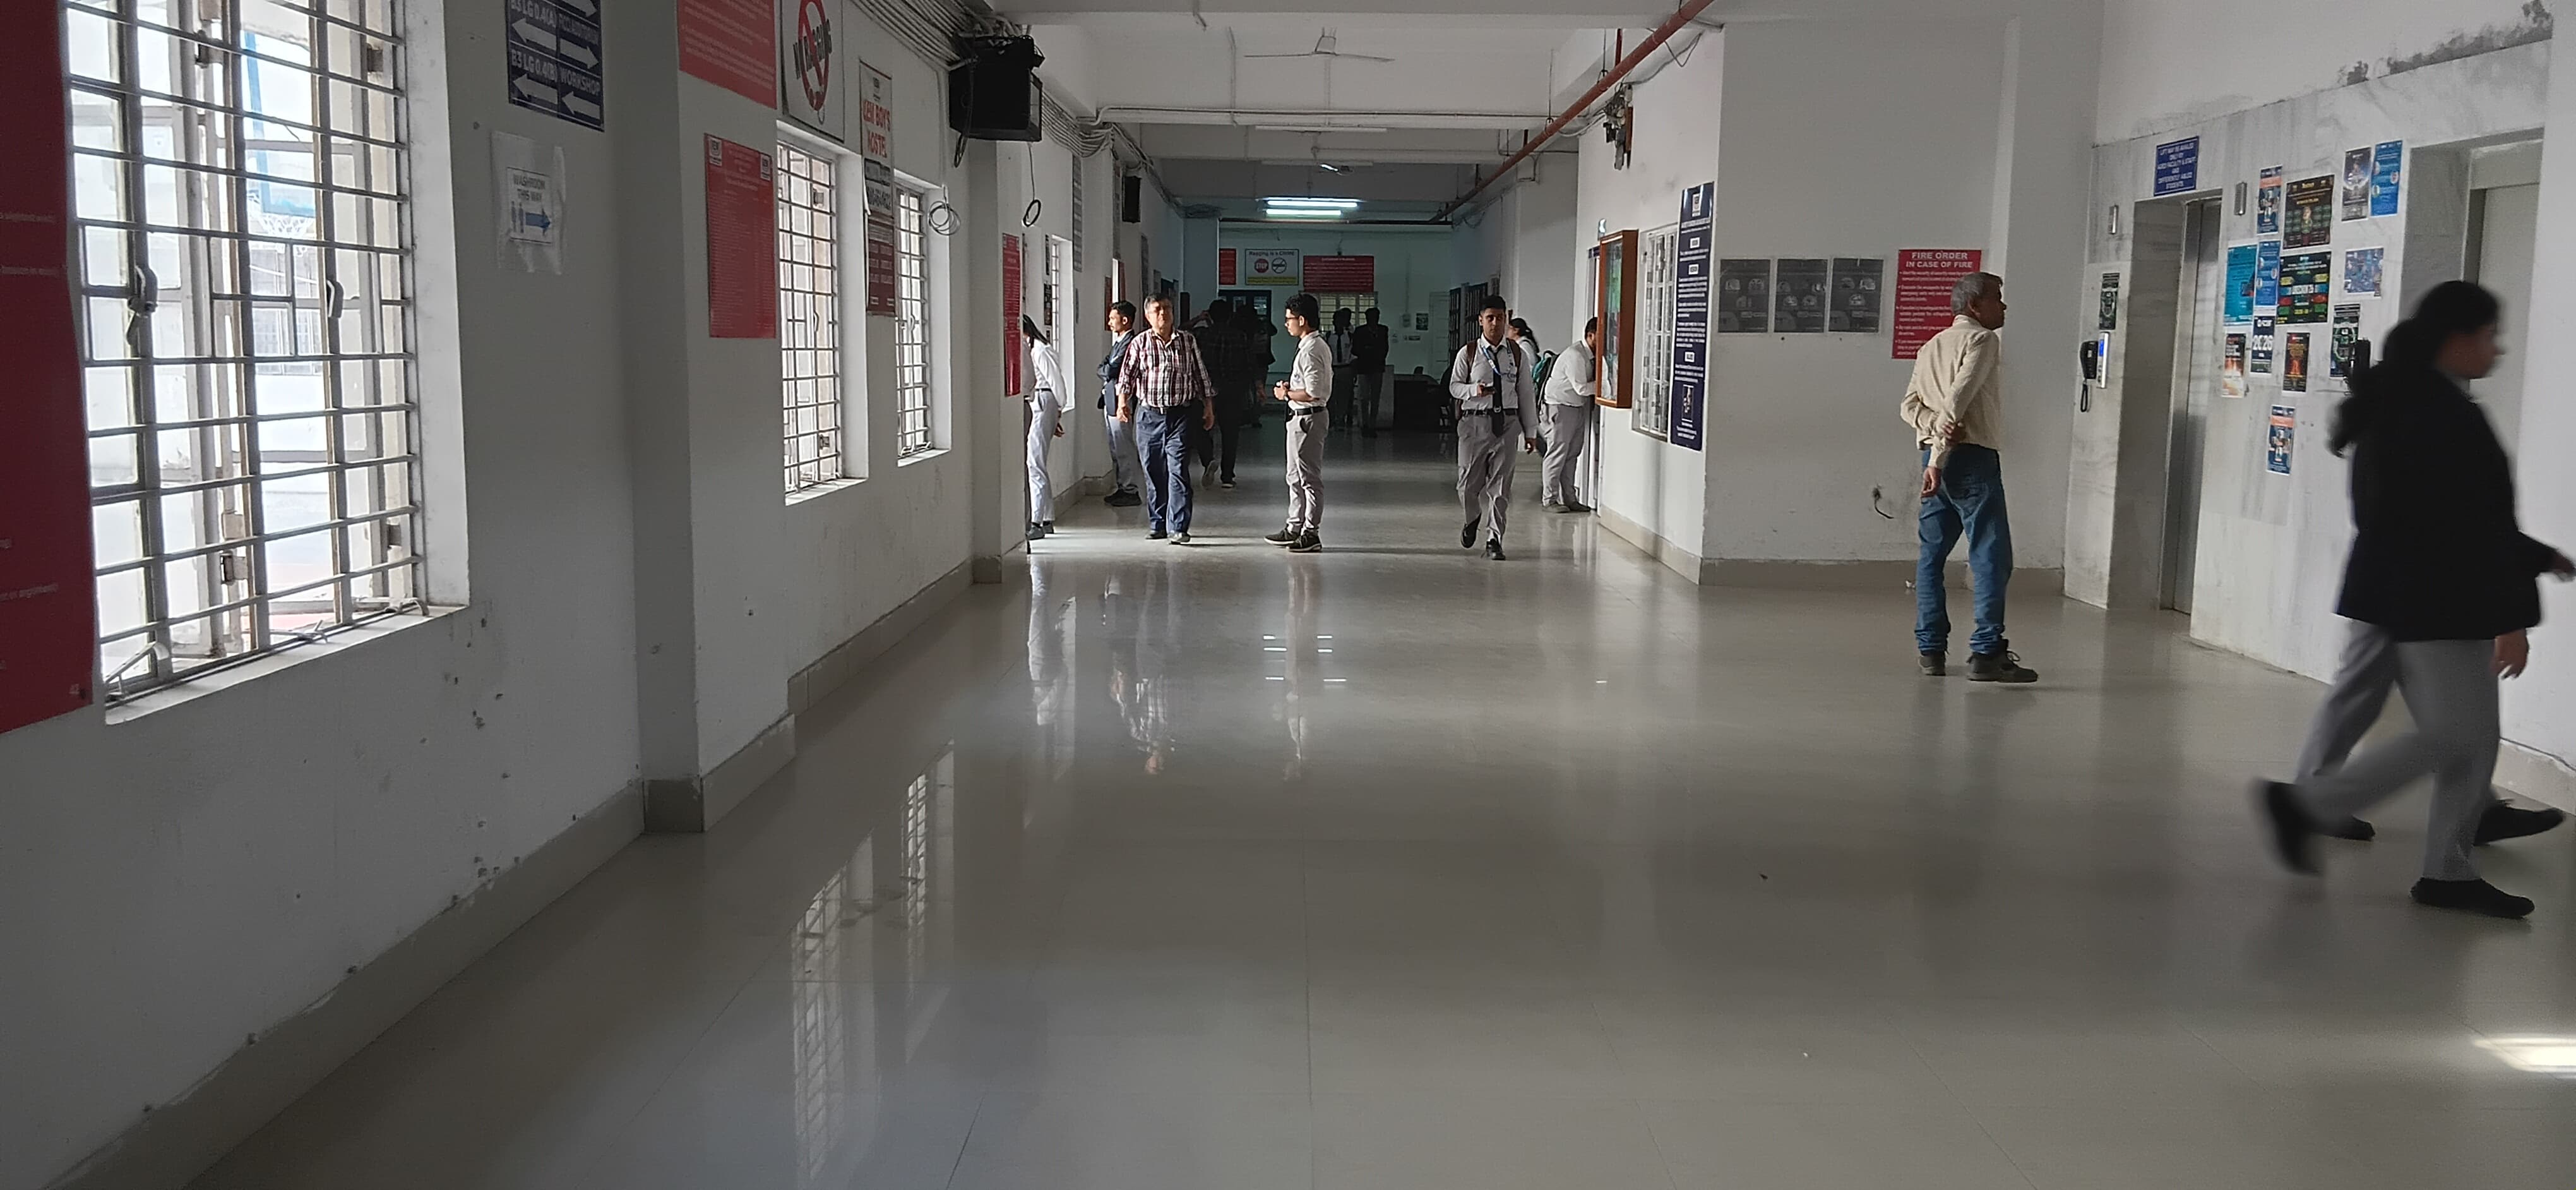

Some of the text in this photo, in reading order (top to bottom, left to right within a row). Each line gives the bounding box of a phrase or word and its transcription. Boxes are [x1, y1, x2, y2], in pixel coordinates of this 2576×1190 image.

[511, 49, 522, 68] B3
[523, 53, 535, 73] LG
[560, 66, 600, 96] WORKSHOP
[513, 173, 546, 189] WASHROOM
[2253, 335, 2274, 351] 2026
